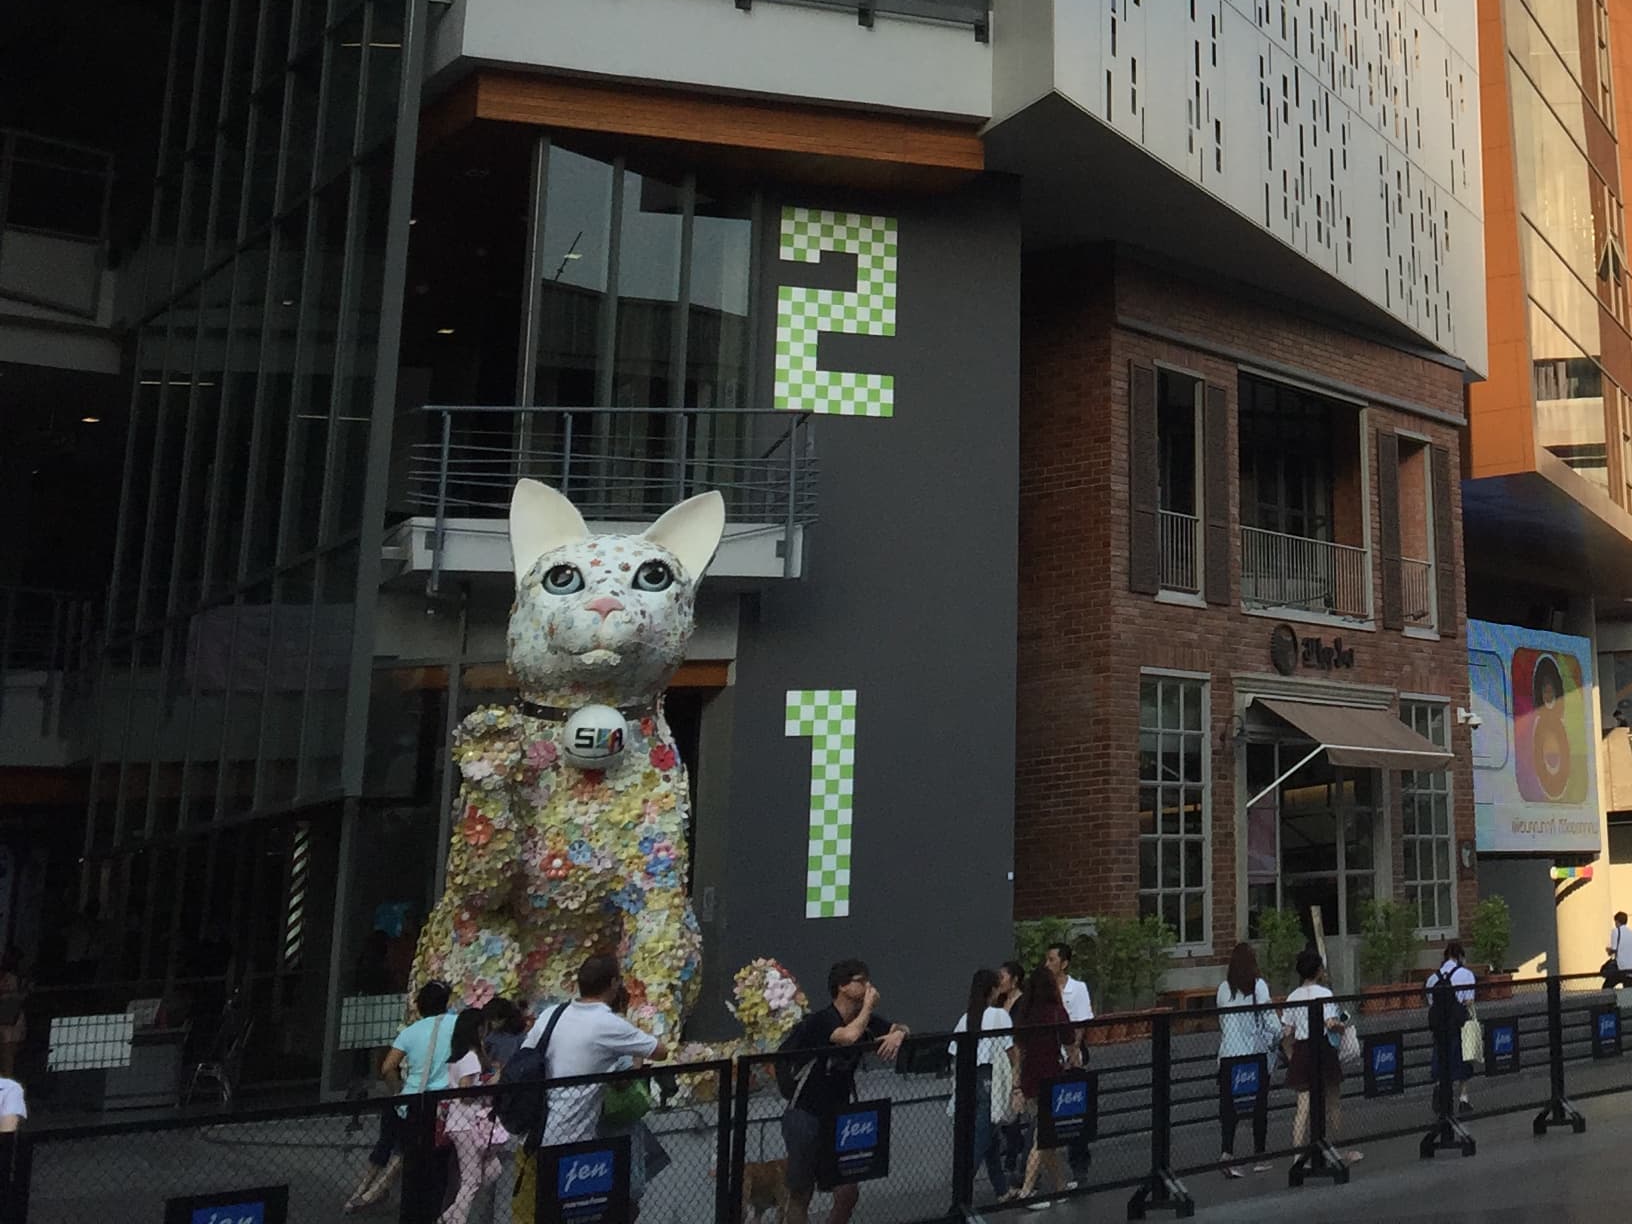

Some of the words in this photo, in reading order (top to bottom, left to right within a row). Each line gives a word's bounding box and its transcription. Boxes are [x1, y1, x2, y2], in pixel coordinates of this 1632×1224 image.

[772, 203, 899, 419] 2
[785, 687, 857, 918] 1
[1232, 1068, 1257, 1092] jen
[1055, 1088, 1084, 1113] jen
[839, 1119, 874, 1147] jen
[564, 1159, 608, 1193] jen
